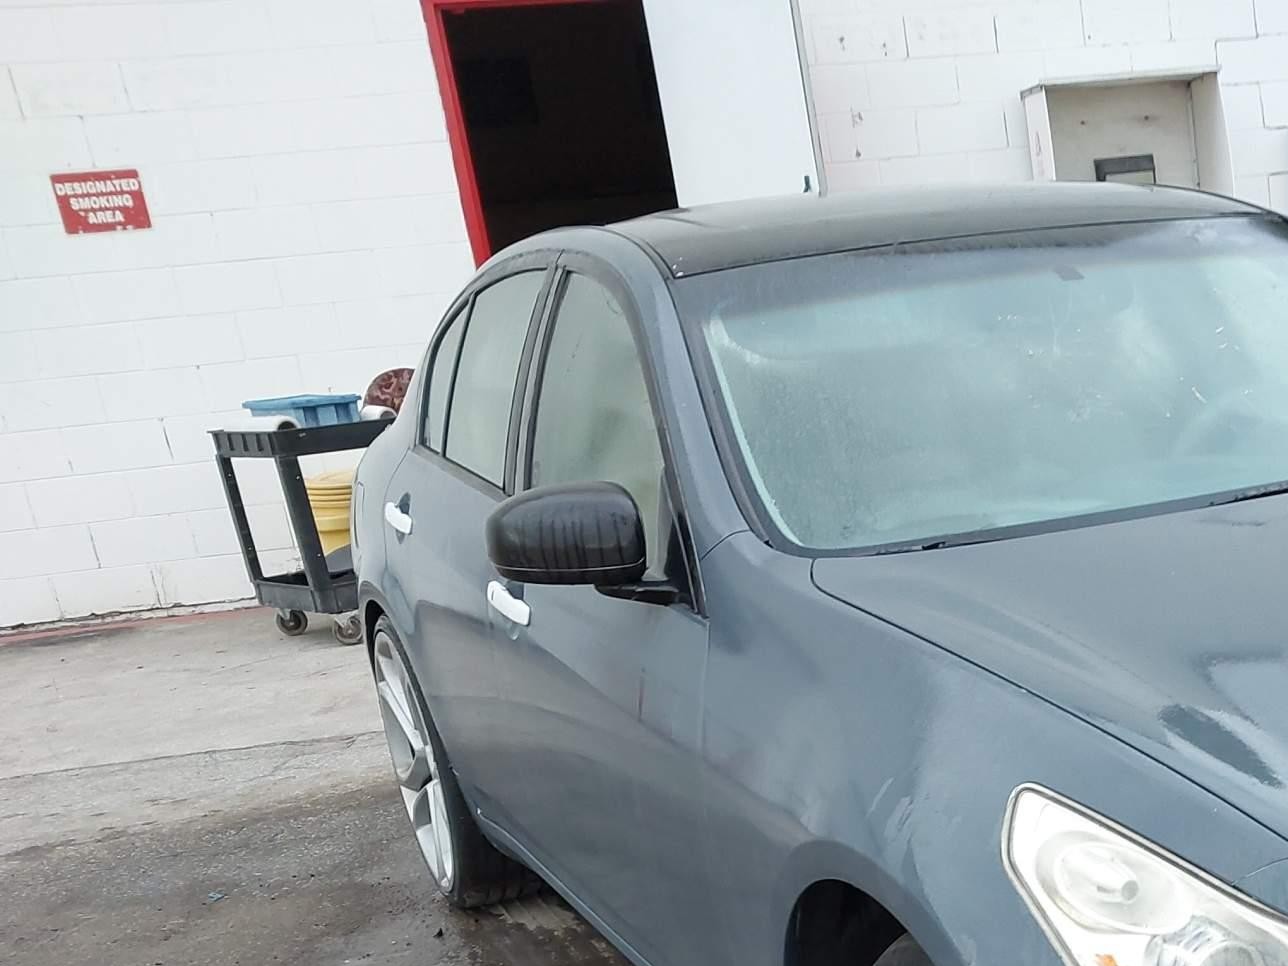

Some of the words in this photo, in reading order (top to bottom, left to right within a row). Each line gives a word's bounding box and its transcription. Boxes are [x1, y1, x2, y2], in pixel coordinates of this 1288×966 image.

[54, 178, 139, 195] DESIGNATED
[69, 194, 134, 210] SMOKING
[88, 210, 125, 224] AREA
